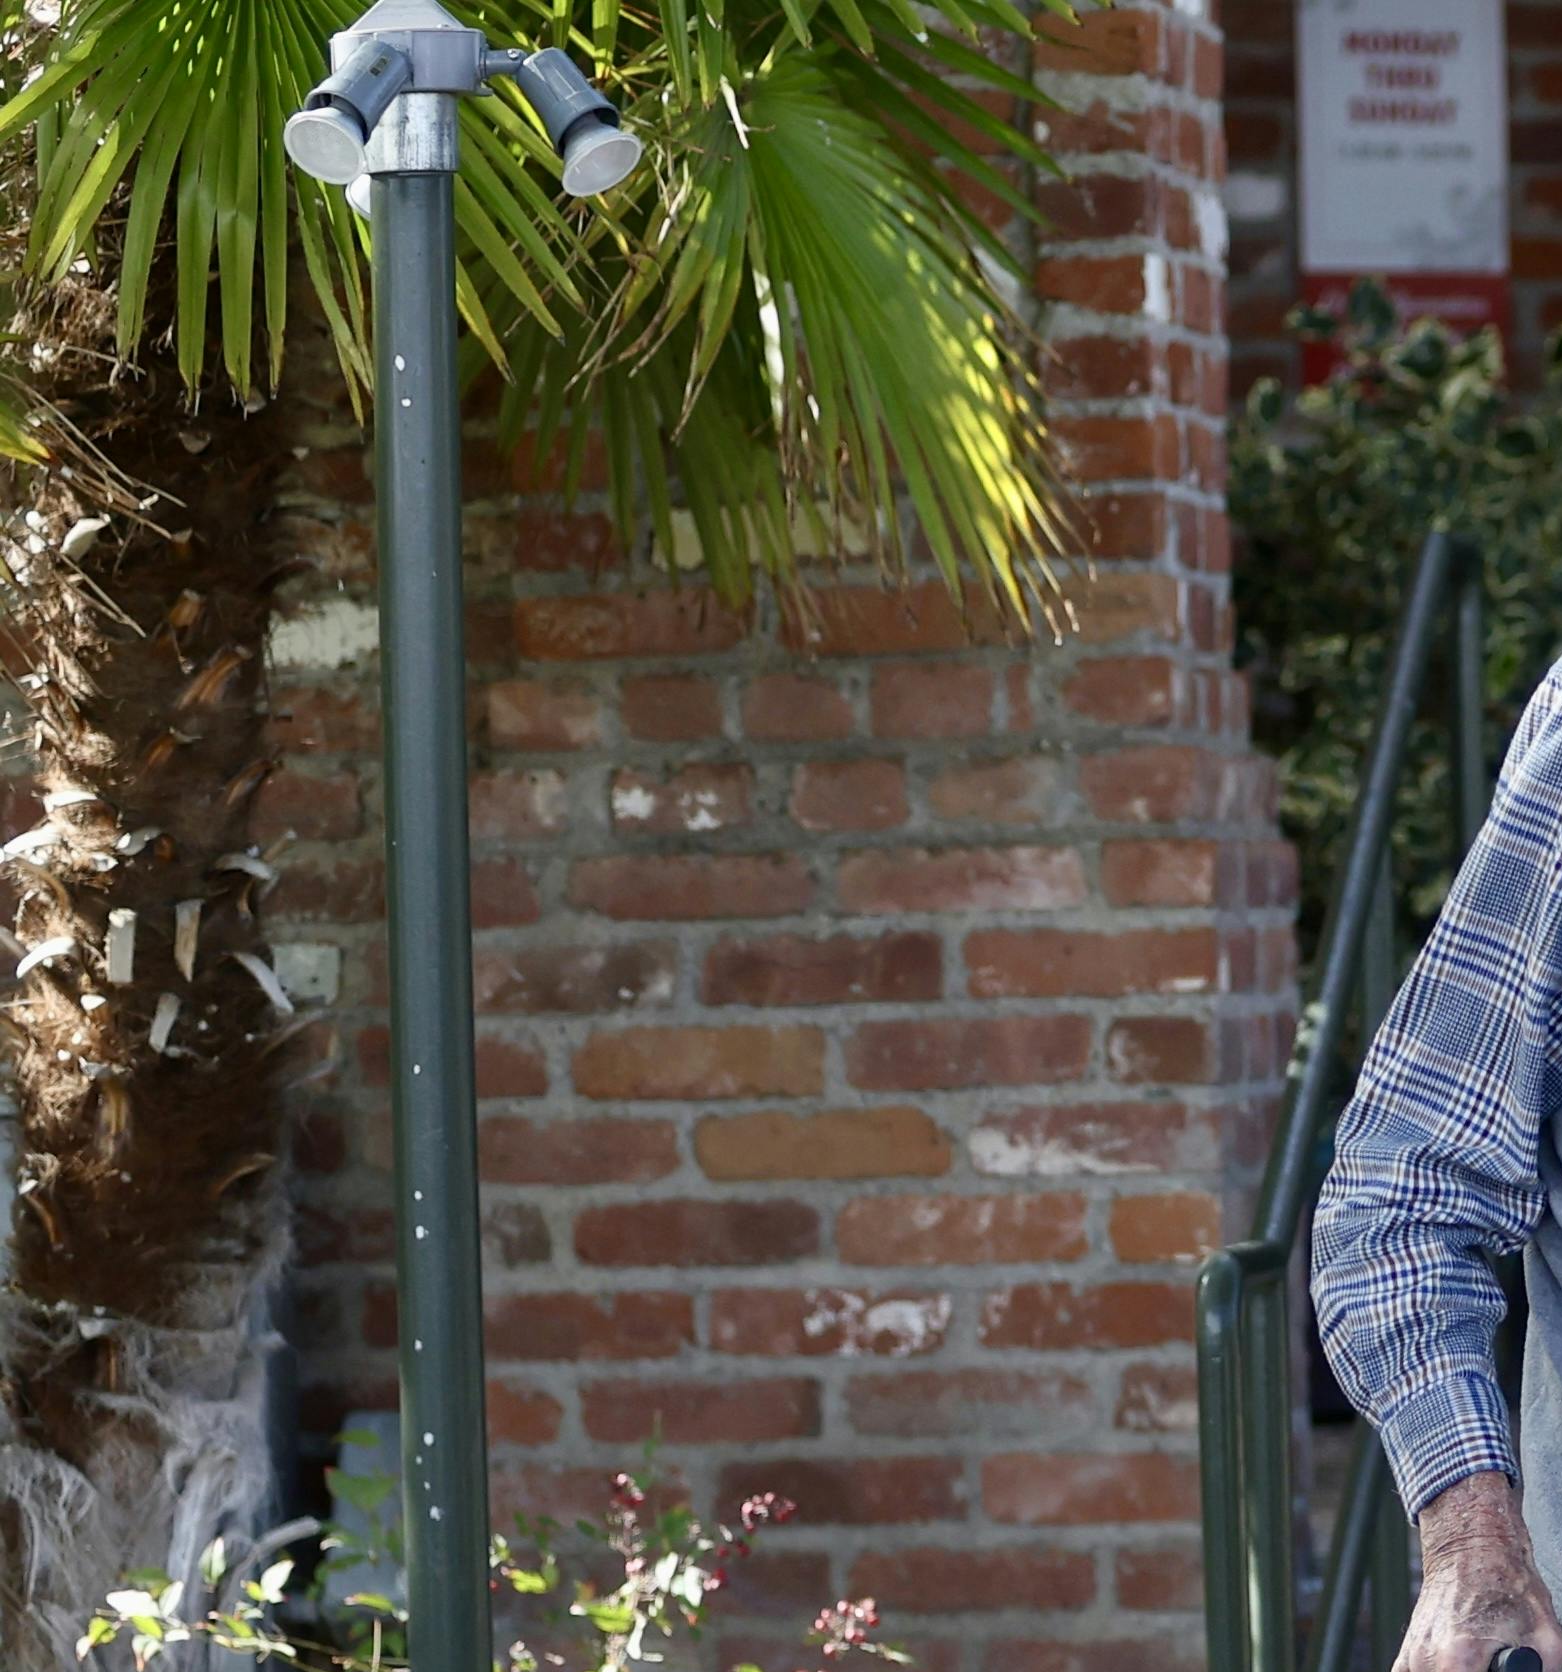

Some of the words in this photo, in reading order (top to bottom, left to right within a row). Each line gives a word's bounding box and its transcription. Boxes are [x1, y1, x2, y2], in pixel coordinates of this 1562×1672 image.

[1344, 31, 1459, 55] MONDAY
[1366, 66, 1439, 89] THRU
[1348, 100, 1457, 124] SUNDAY
